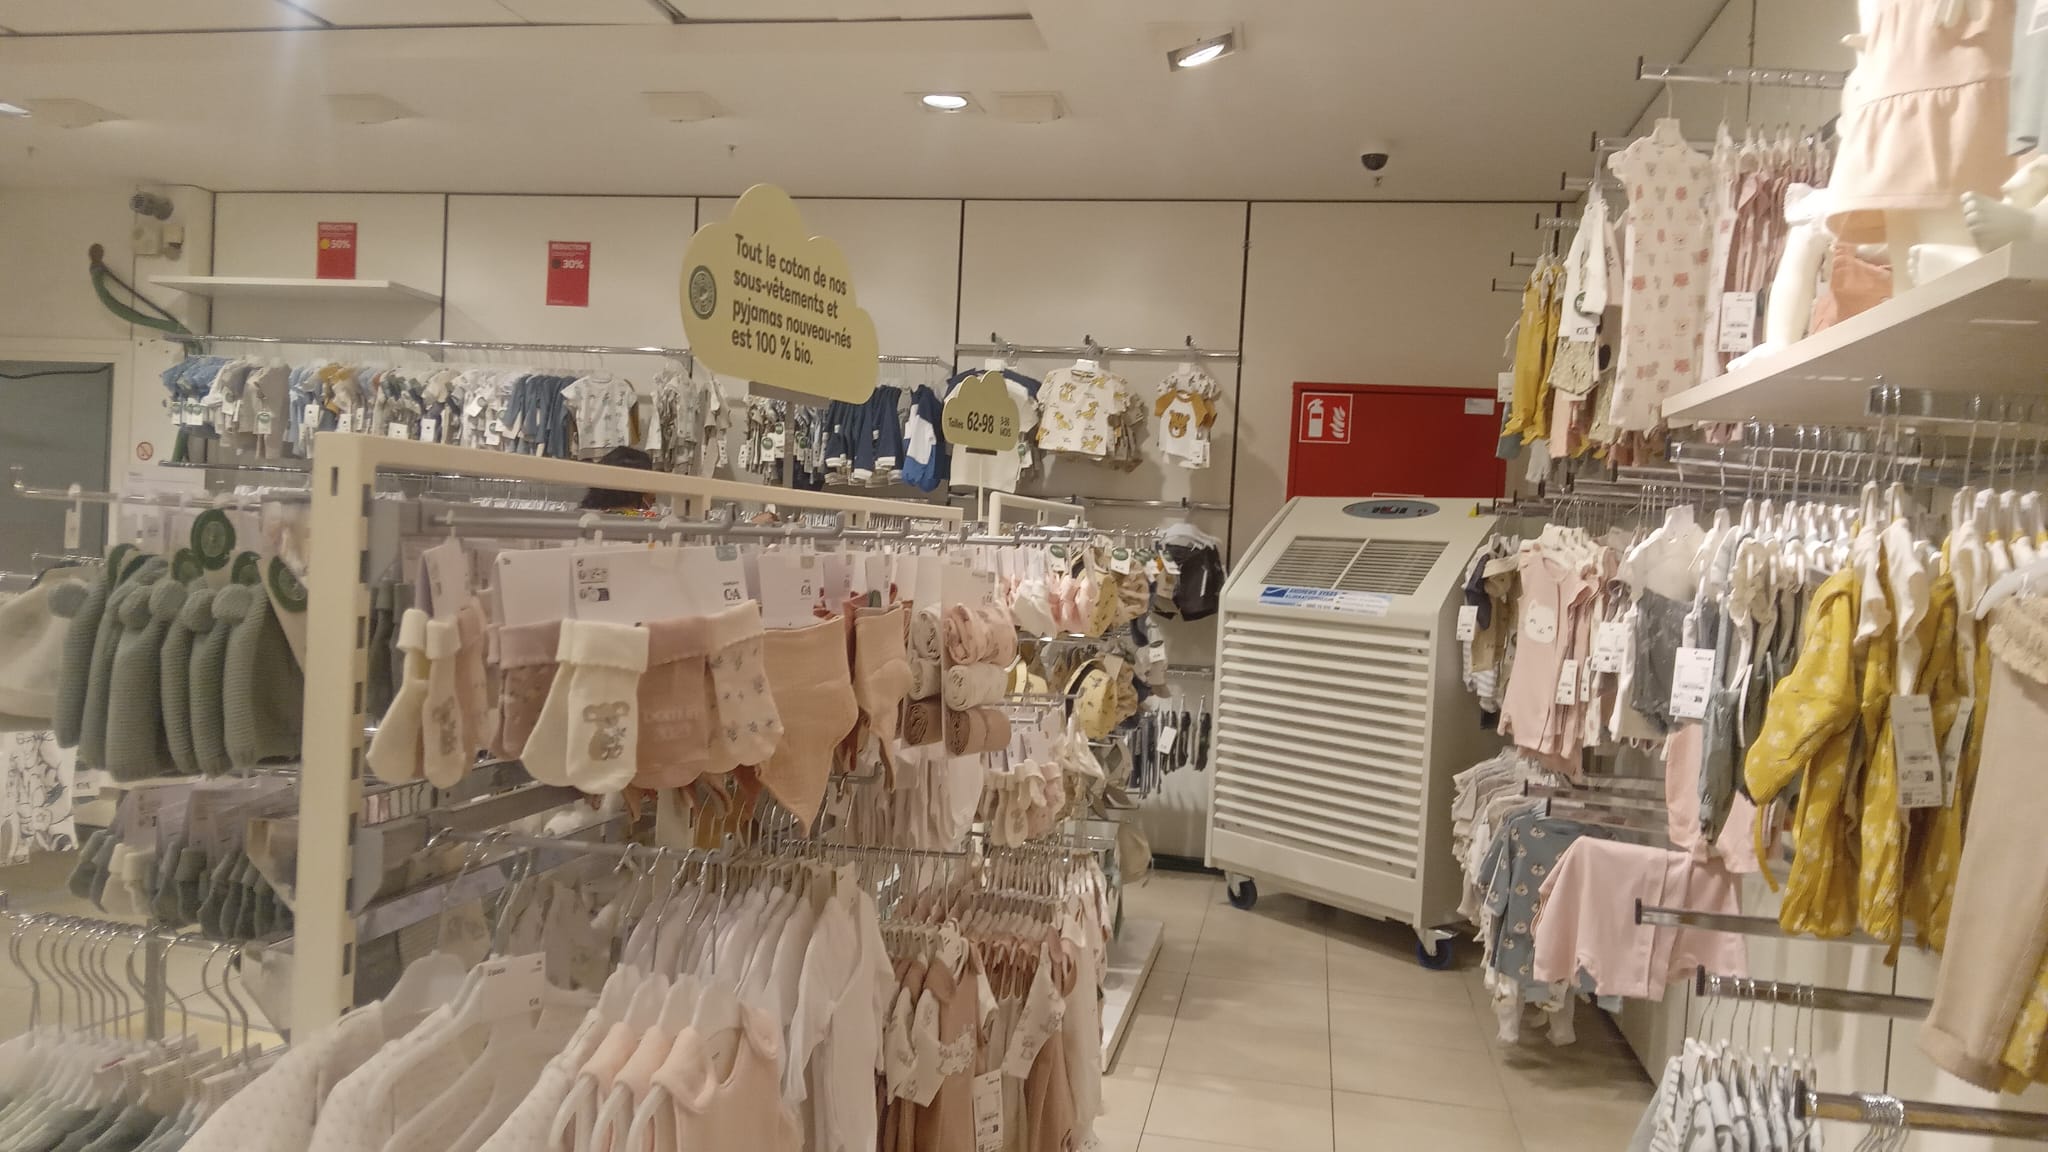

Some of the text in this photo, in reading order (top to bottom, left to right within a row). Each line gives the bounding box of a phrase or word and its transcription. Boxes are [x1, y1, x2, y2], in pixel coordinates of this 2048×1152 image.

[562, 259, 585, 270] 30%
[735, 233, 847, 296] Tout le coton de nos
[733, 269, 839, 319] sous-vêtements et
[732, 297, 852, 349] pyjamas nouveau-nés
[732, 329, 814, 365] est 100 % bio.
